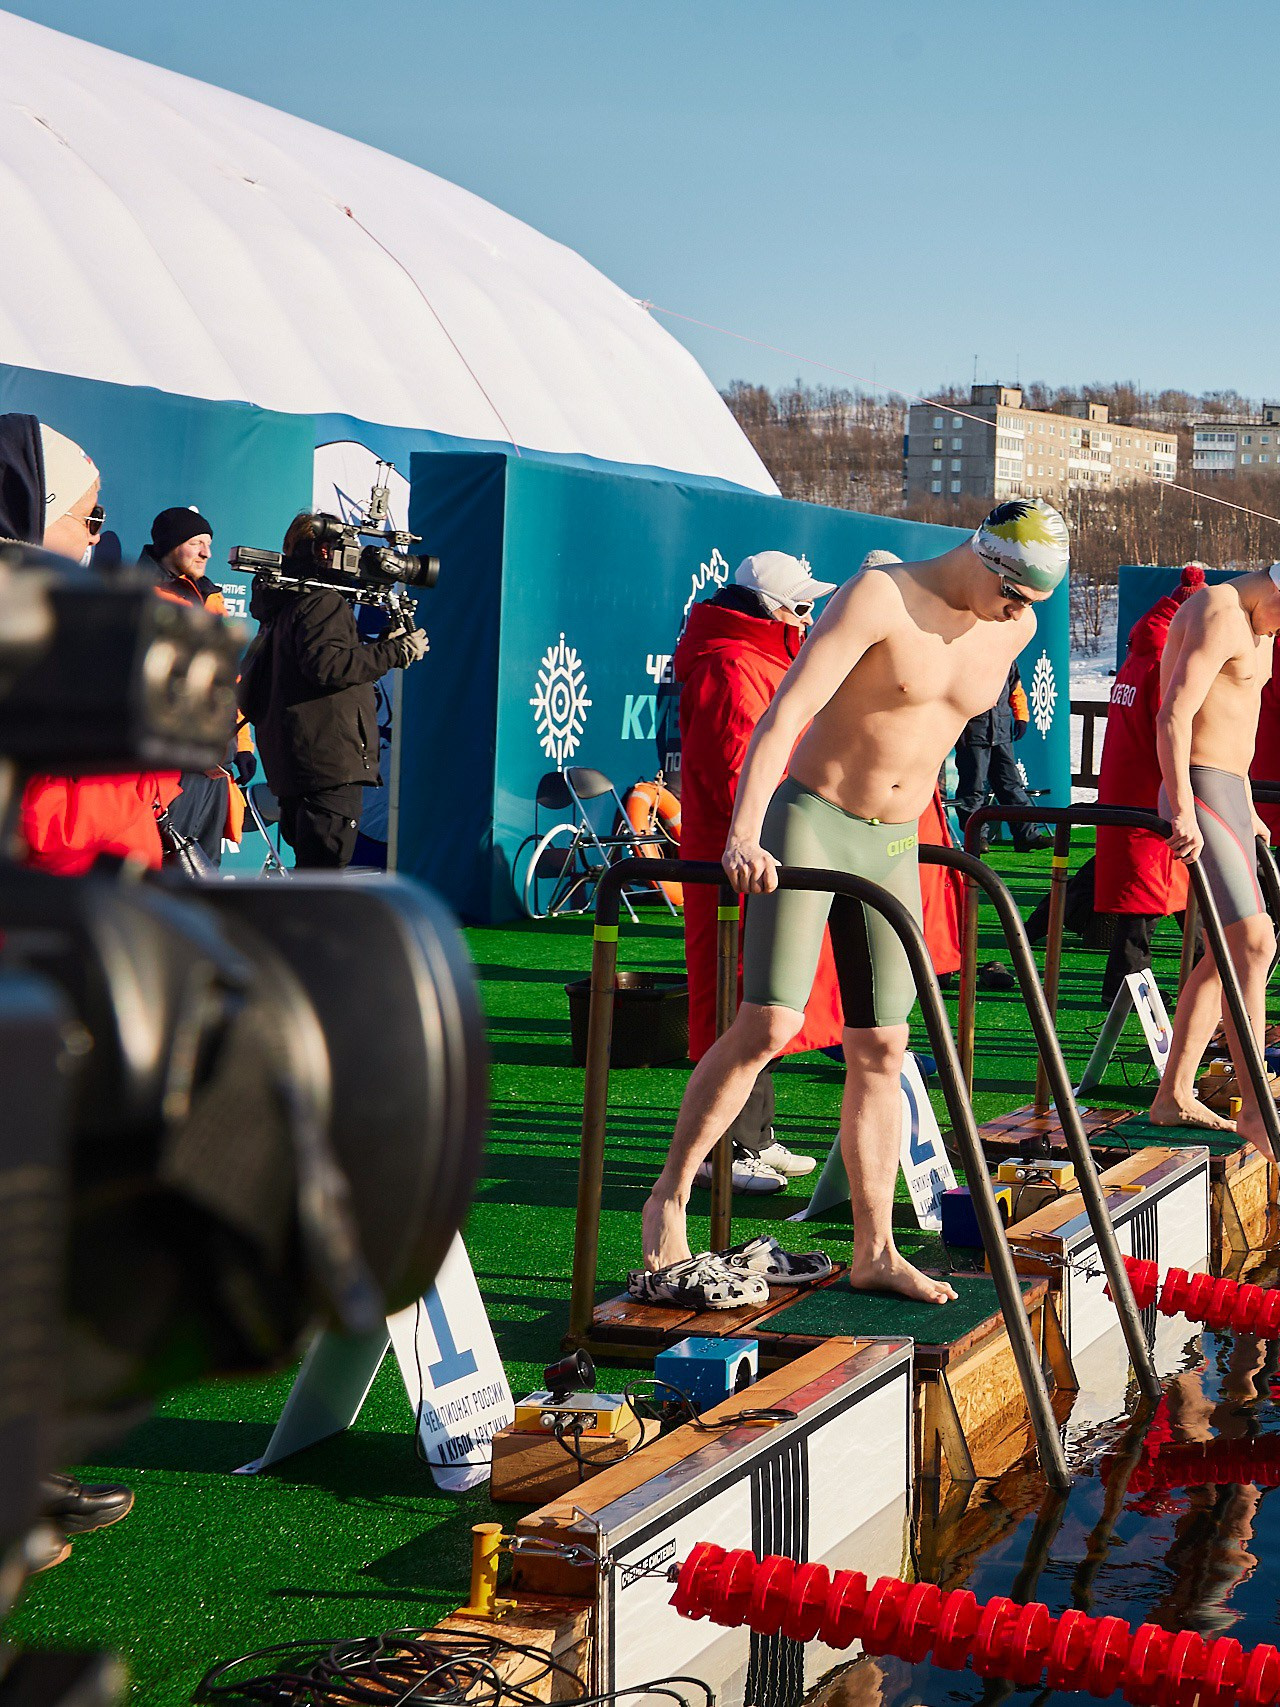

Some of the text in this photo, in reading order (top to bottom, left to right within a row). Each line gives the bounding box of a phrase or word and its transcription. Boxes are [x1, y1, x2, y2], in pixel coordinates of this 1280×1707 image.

[900, 1072, 937, 1167] 2
[421, 1280, 479, 1390] 1
[422, 1381, 506, 1434] ЧЕМПИОНАТ РОССИИ
[437, 1443, 448, 1465] И
[445, 1431, 475, 1462] КУБОК
